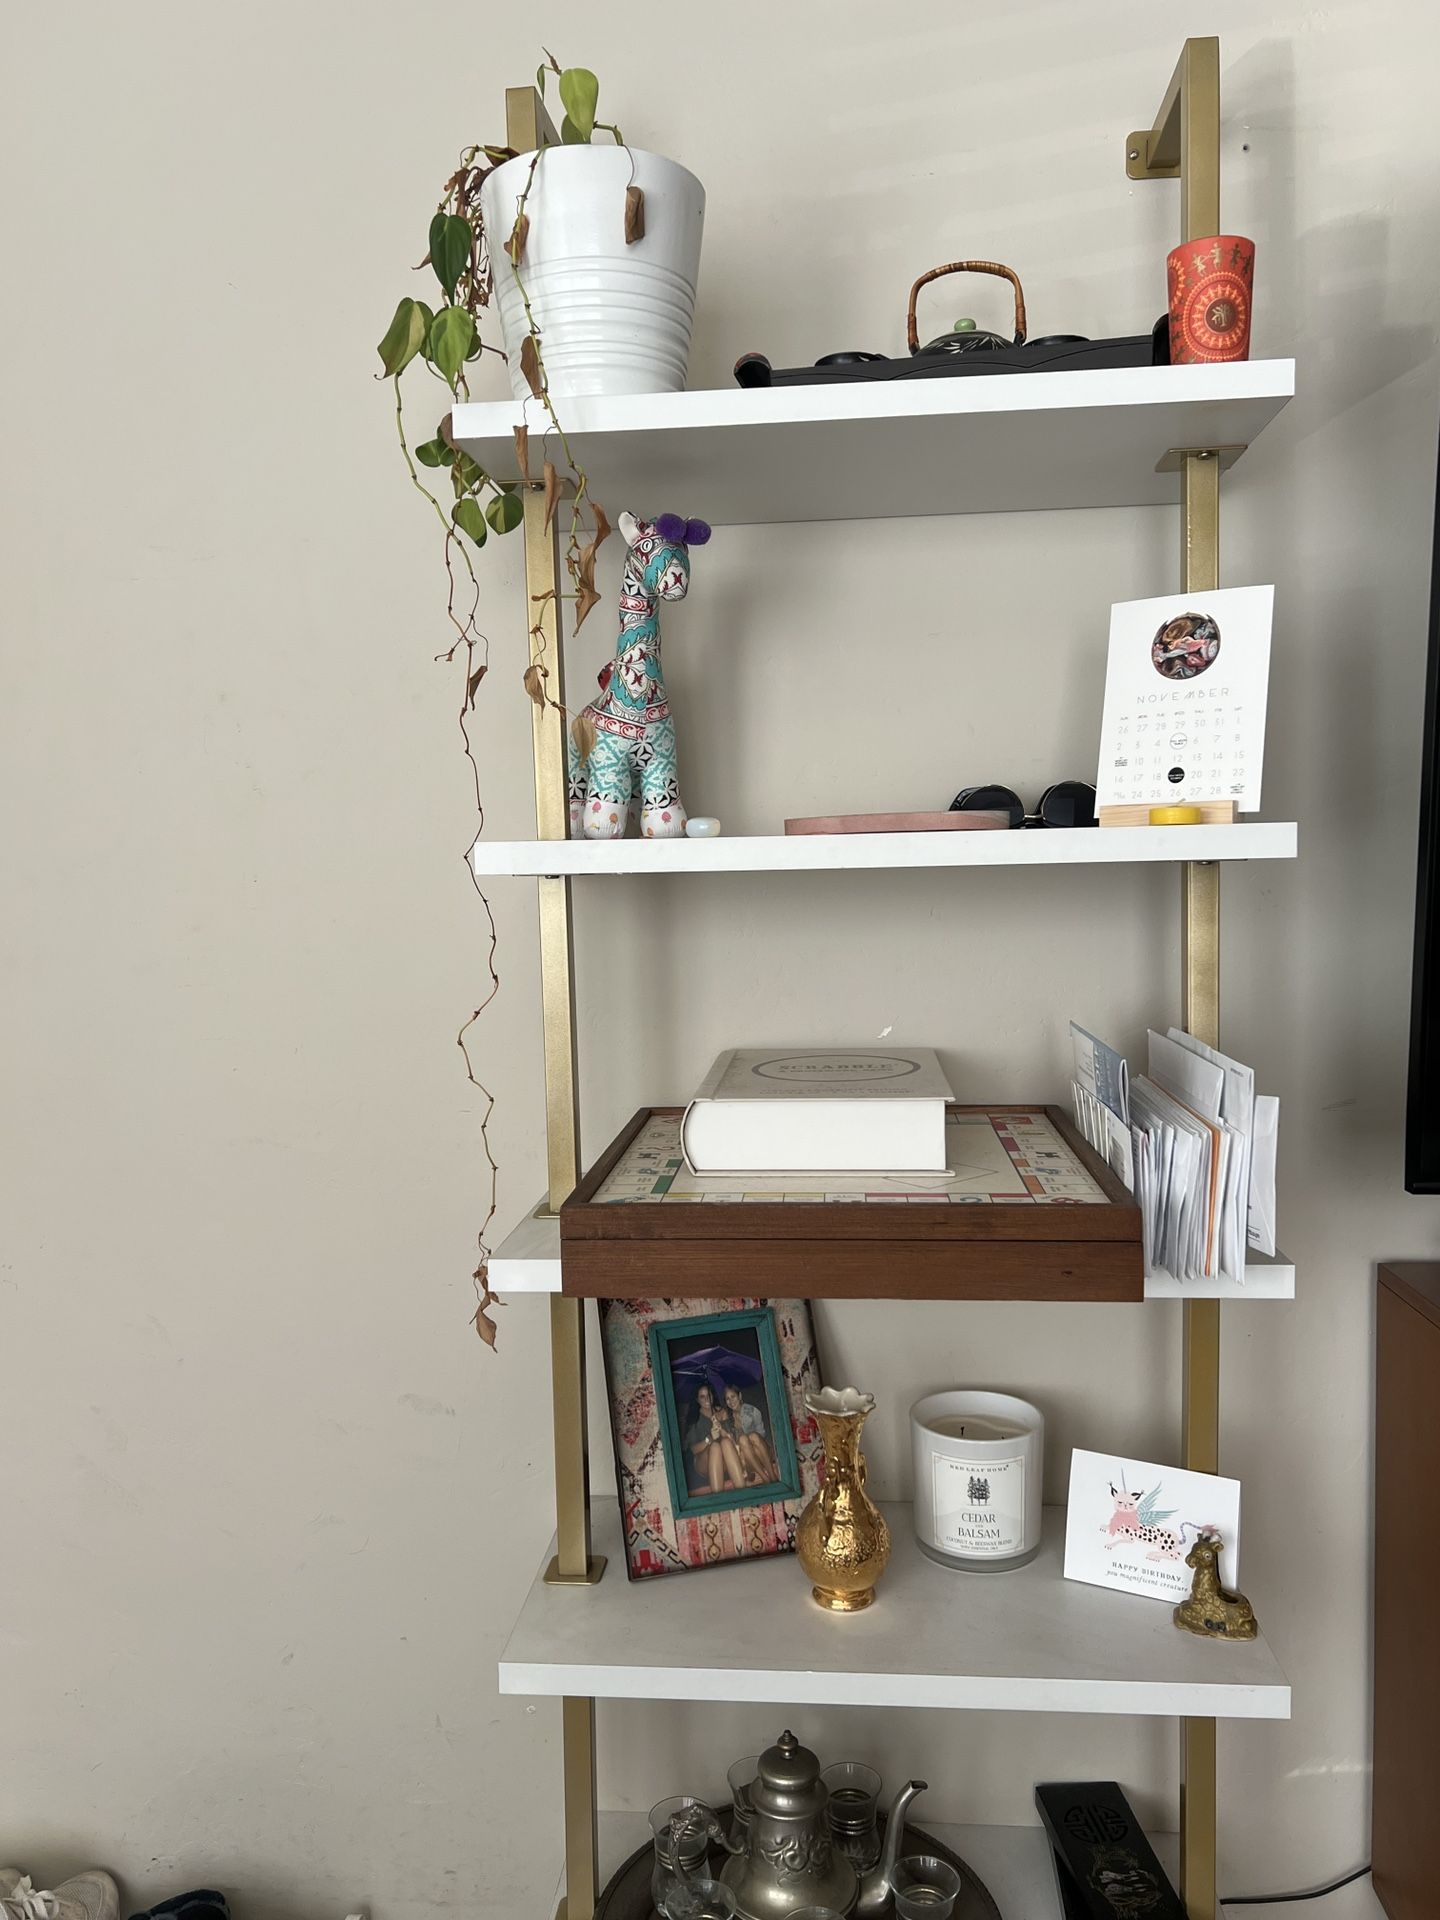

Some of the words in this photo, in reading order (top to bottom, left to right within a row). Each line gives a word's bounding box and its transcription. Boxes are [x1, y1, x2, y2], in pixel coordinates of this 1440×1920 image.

[1136, 687, 1230, 704] NOVEMBER
[1173, 753, 1183, 763] 12
[961, 1512, 996, 1523] CEDAR
[958, 1527, 1000, 1539] BALSAM
[1112, 1561, 1138, 1572] HAPPY
[1120, 1572, 1158, 1585] magnificent
[1160, 1582, 1188, 1592] creature
